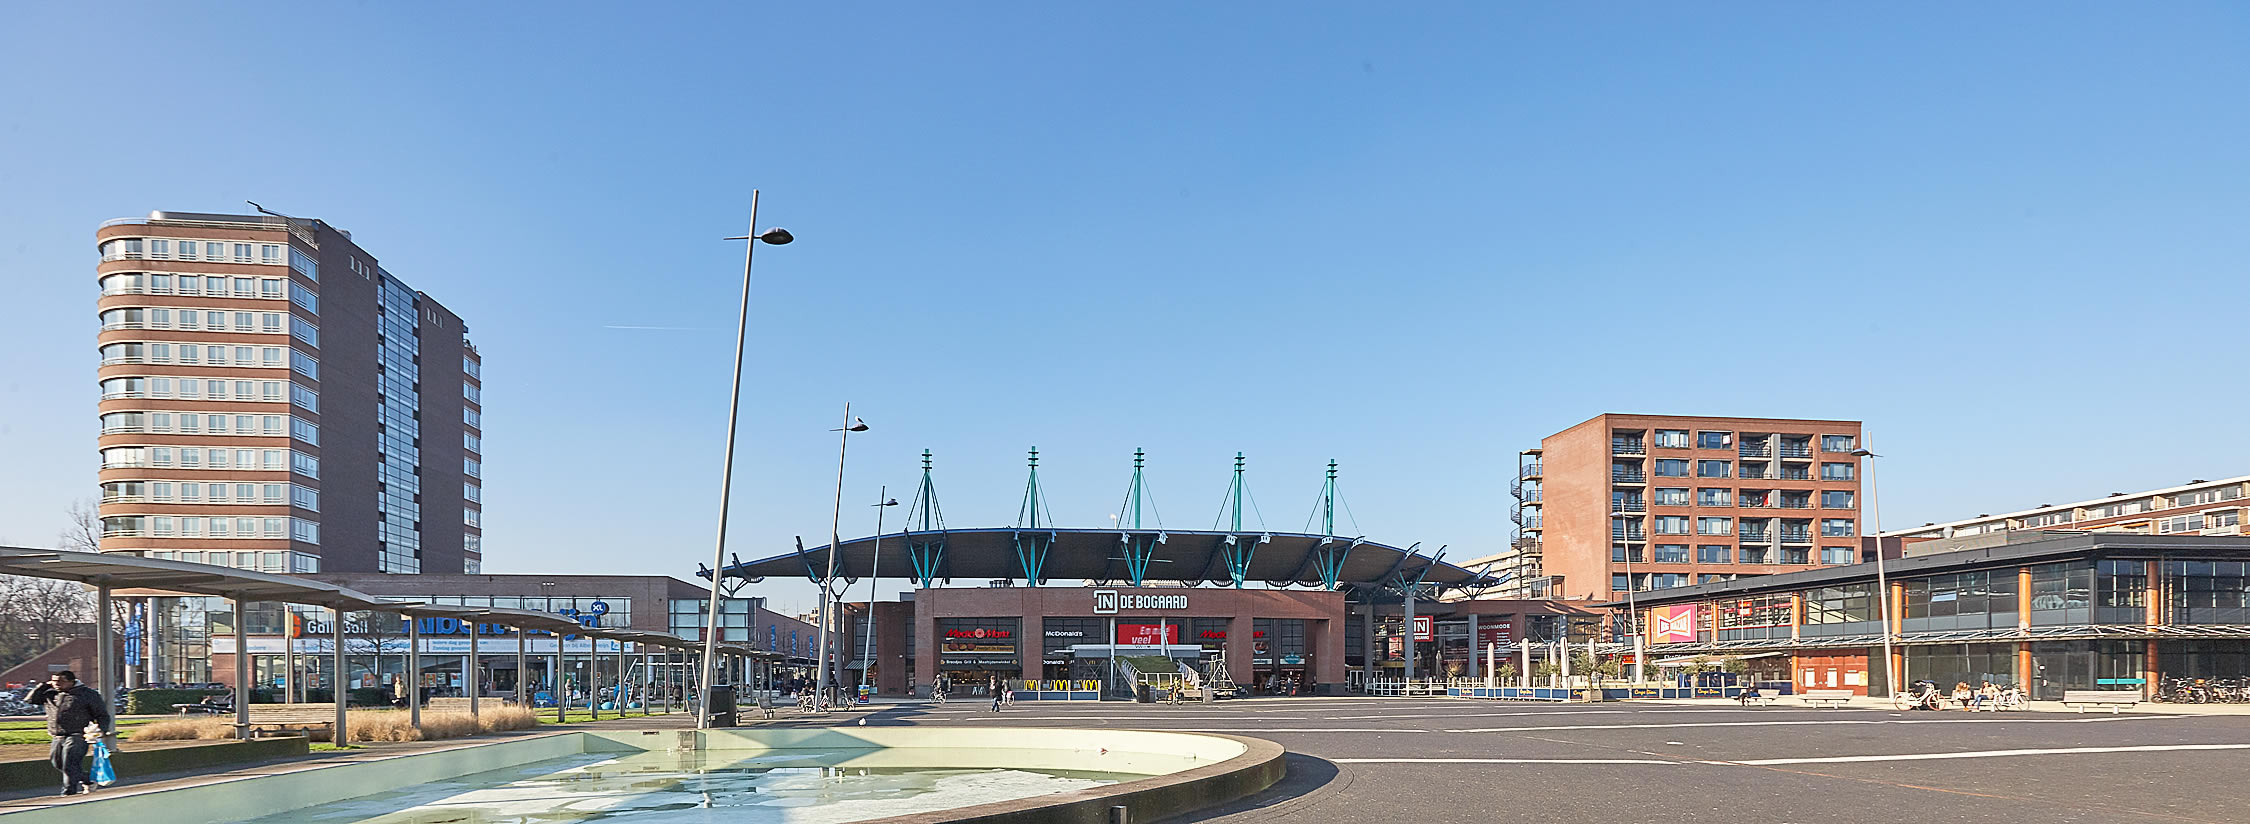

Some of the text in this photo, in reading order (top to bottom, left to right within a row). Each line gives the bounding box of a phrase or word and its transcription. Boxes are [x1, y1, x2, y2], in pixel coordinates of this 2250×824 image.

[1098, 594, 1188, 609] IN DE BOGAARD
[592, 603, 604, 611] XL
[307, 620, 333, 634] Gall
[1478, 623, 1511, 631] WOONMODE
[1045, 630, 1083, 638] McDonald's
[1131, 635, 1152, 645] veel
